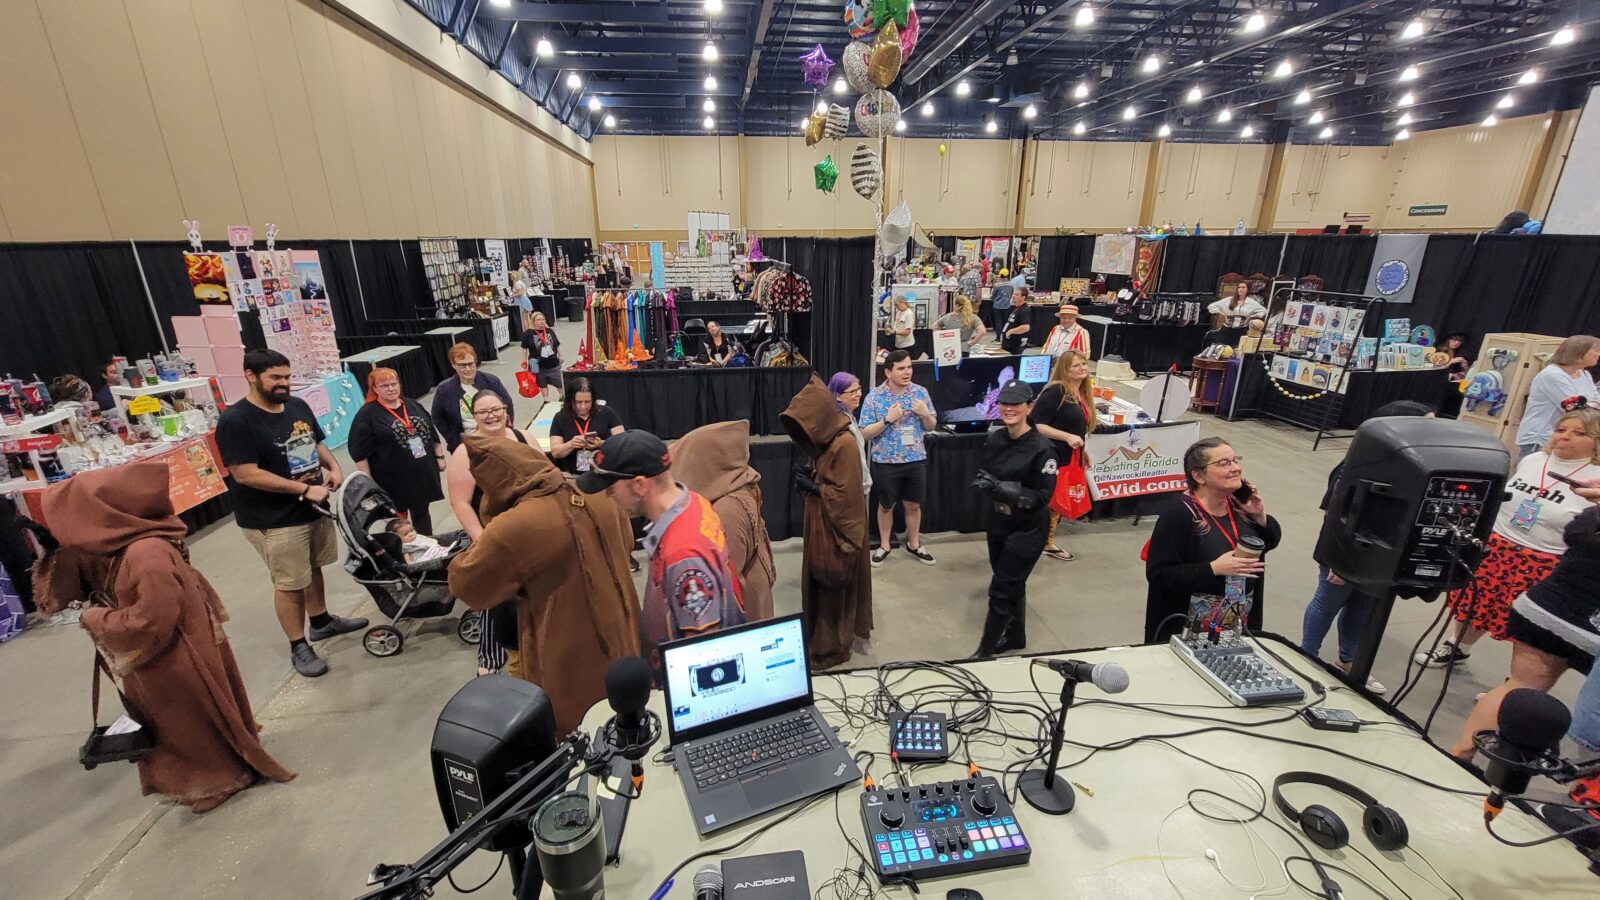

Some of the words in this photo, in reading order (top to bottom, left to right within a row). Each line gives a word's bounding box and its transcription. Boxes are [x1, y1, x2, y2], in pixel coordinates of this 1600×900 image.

[1092, 460, 1140, 473] lebrating
[1144, 457, 1179, 468] Florida
[1099, 479, 1188, 498] cVid.com
[1508, 478, 1566, 504] Sarah
[1421, 527, 1448, 536] PYLE
[449, 766, 475, 782] PYLE
[733, 875, 796, 890] ANDSCAPE
